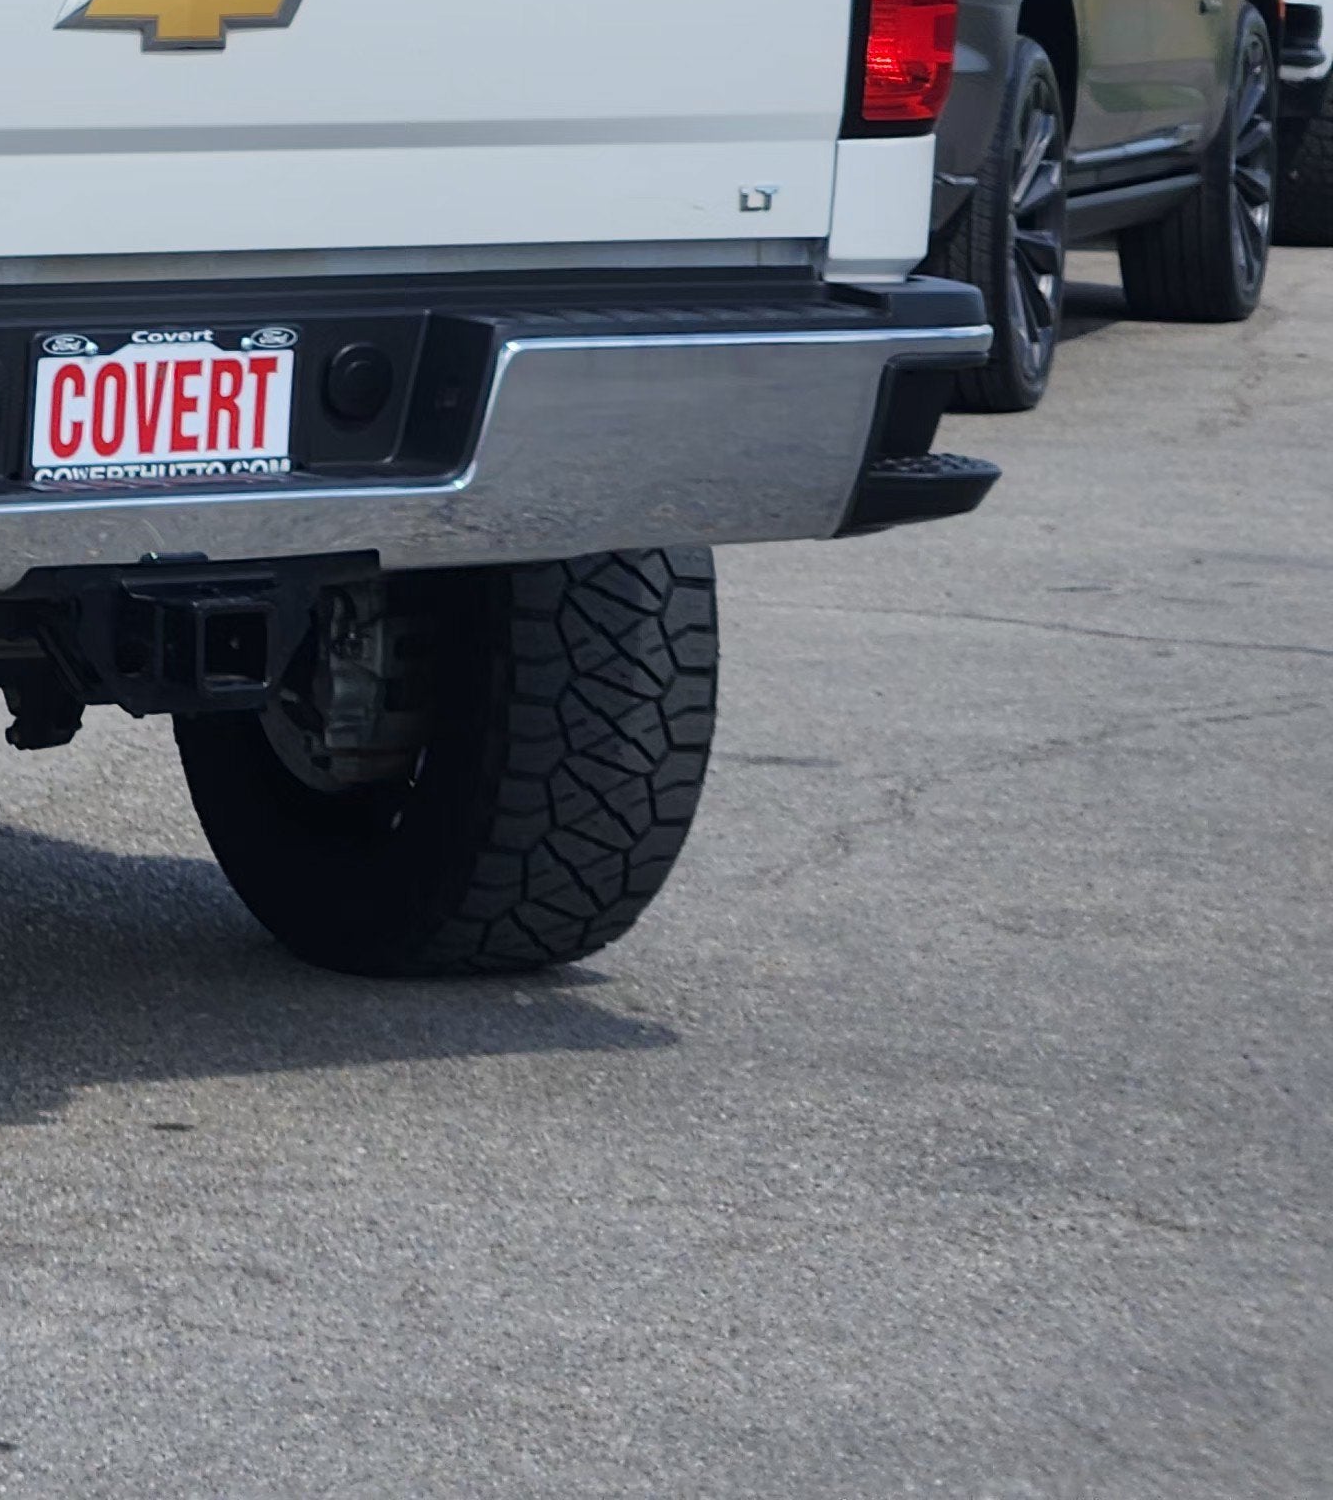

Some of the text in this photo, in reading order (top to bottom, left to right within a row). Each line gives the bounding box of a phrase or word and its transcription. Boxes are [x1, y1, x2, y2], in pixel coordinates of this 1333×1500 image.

[131, 329, 214, 344] Covert
[49, 356, 278, 459] COVERT
[34, 457, 291, 482] COVERTHUTTOCOM
